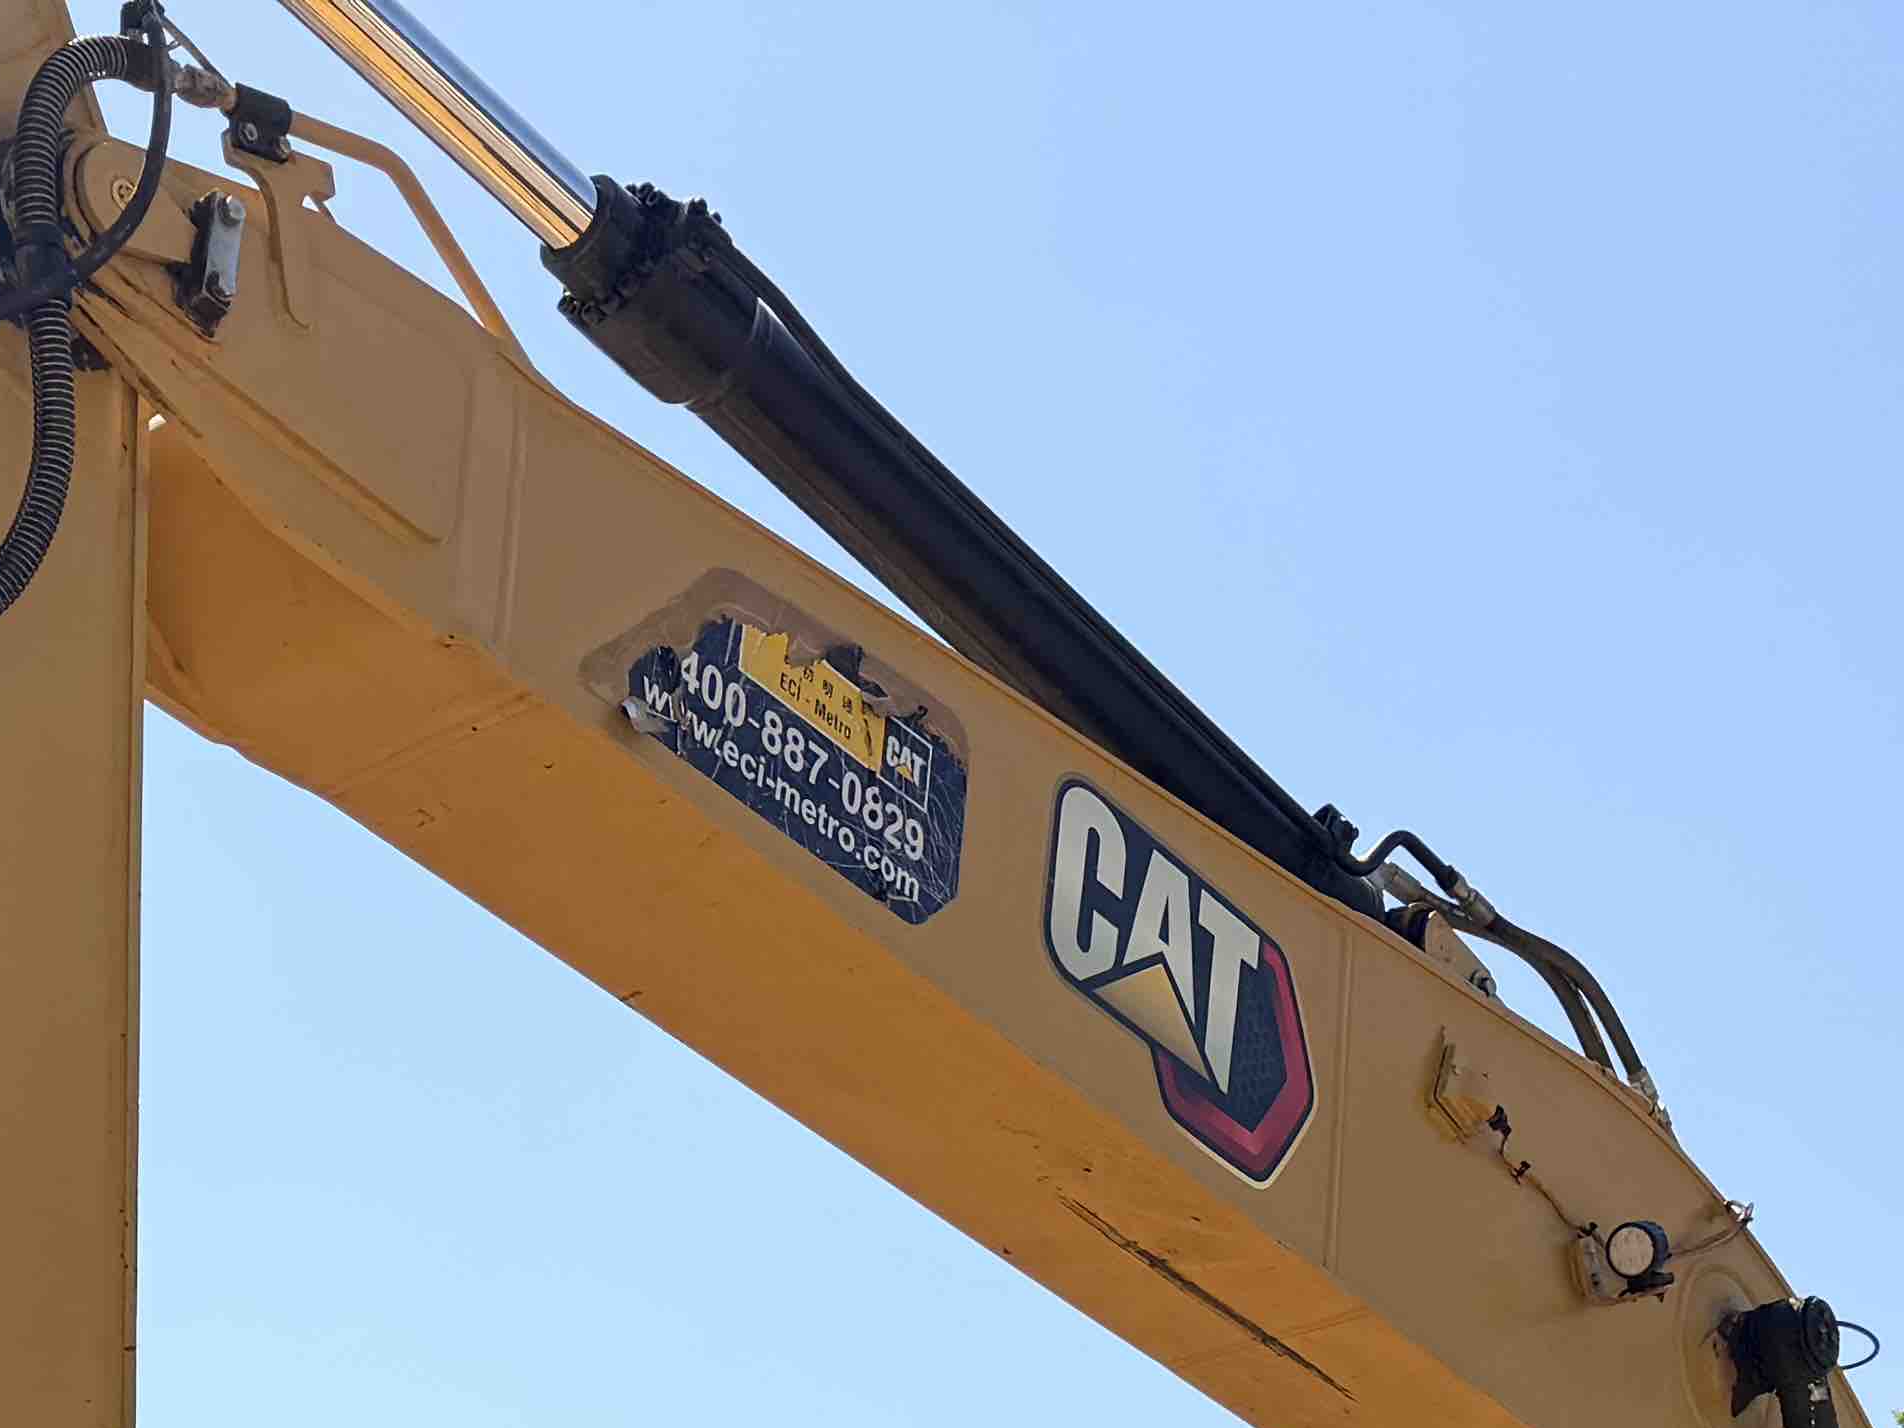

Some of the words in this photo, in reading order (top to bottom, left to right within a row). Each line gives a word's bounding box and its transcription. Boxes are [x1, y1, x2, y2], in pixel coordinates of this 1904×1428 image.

[681, 651, 925, 861] 400-887-0829
[814, 697, 853, 740] Metro
[885, 735, 928, 787] CAT
[1050, 786, 1261, 1095] CAT
